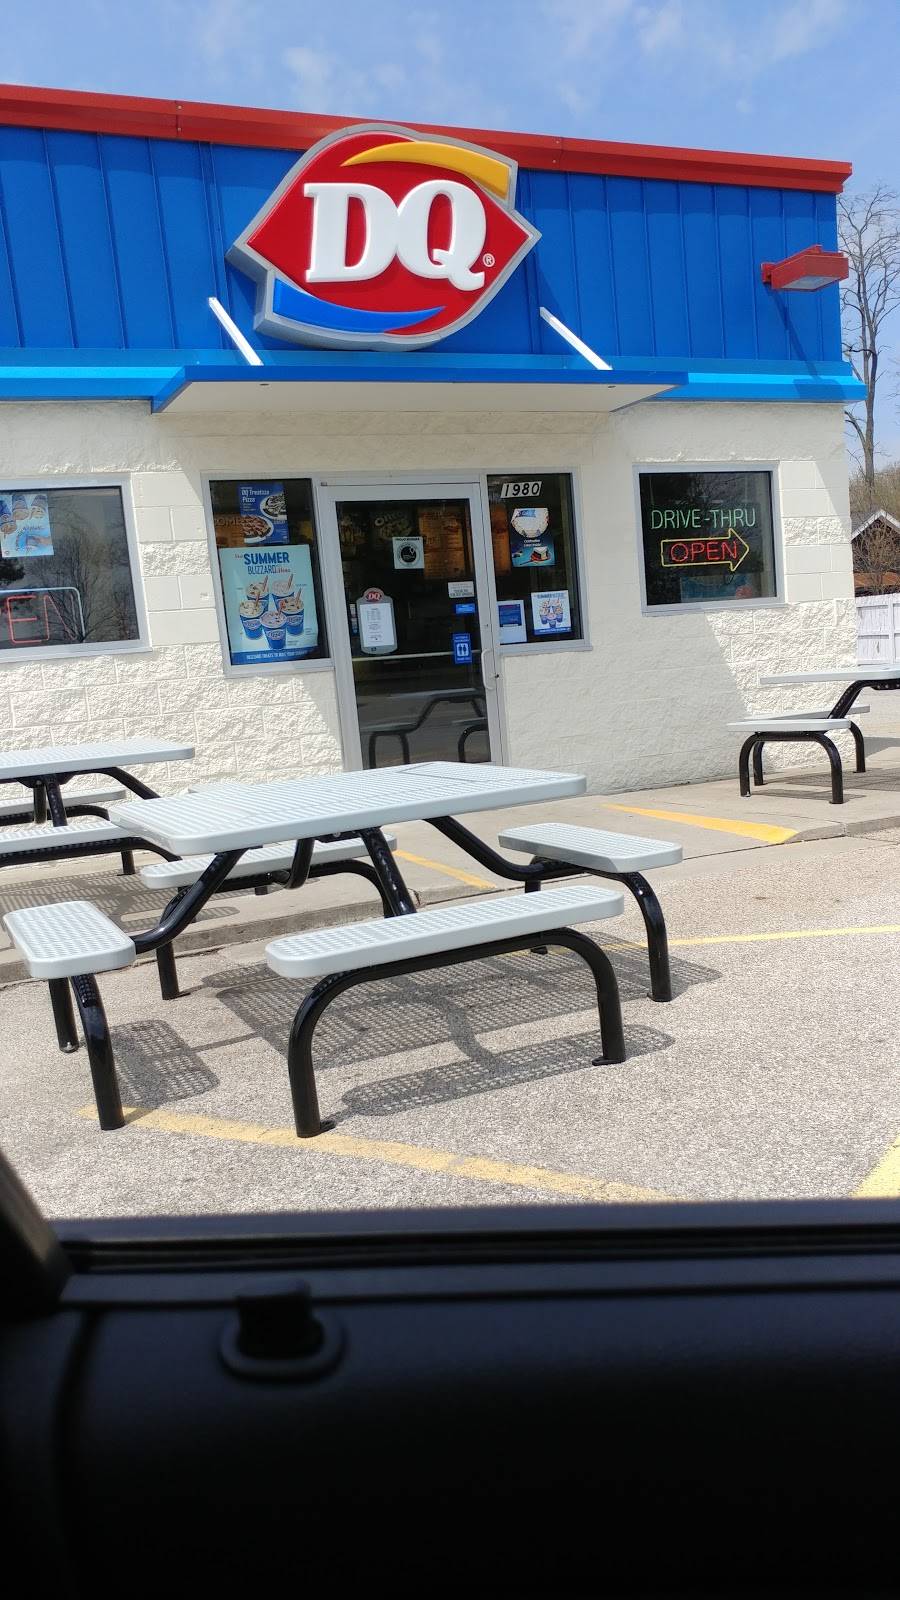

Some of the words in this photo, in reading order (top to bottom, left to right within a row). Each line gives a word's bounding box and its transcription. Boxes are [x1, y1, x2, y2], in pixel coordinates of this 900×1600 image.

[303, 179, 486, 292] DQ
[241, 489, 249, 497] DQ
[505, 482, 540, 497] 1980
[650, 507, 756, 530] DRIVE-THRU
[243, 551, 290, 566] SUMMER
[670, 540, 738, 563] OPEN
[247, 564, 276, 575] BLIZZARD
[367, 592, 381, 600] DQ
